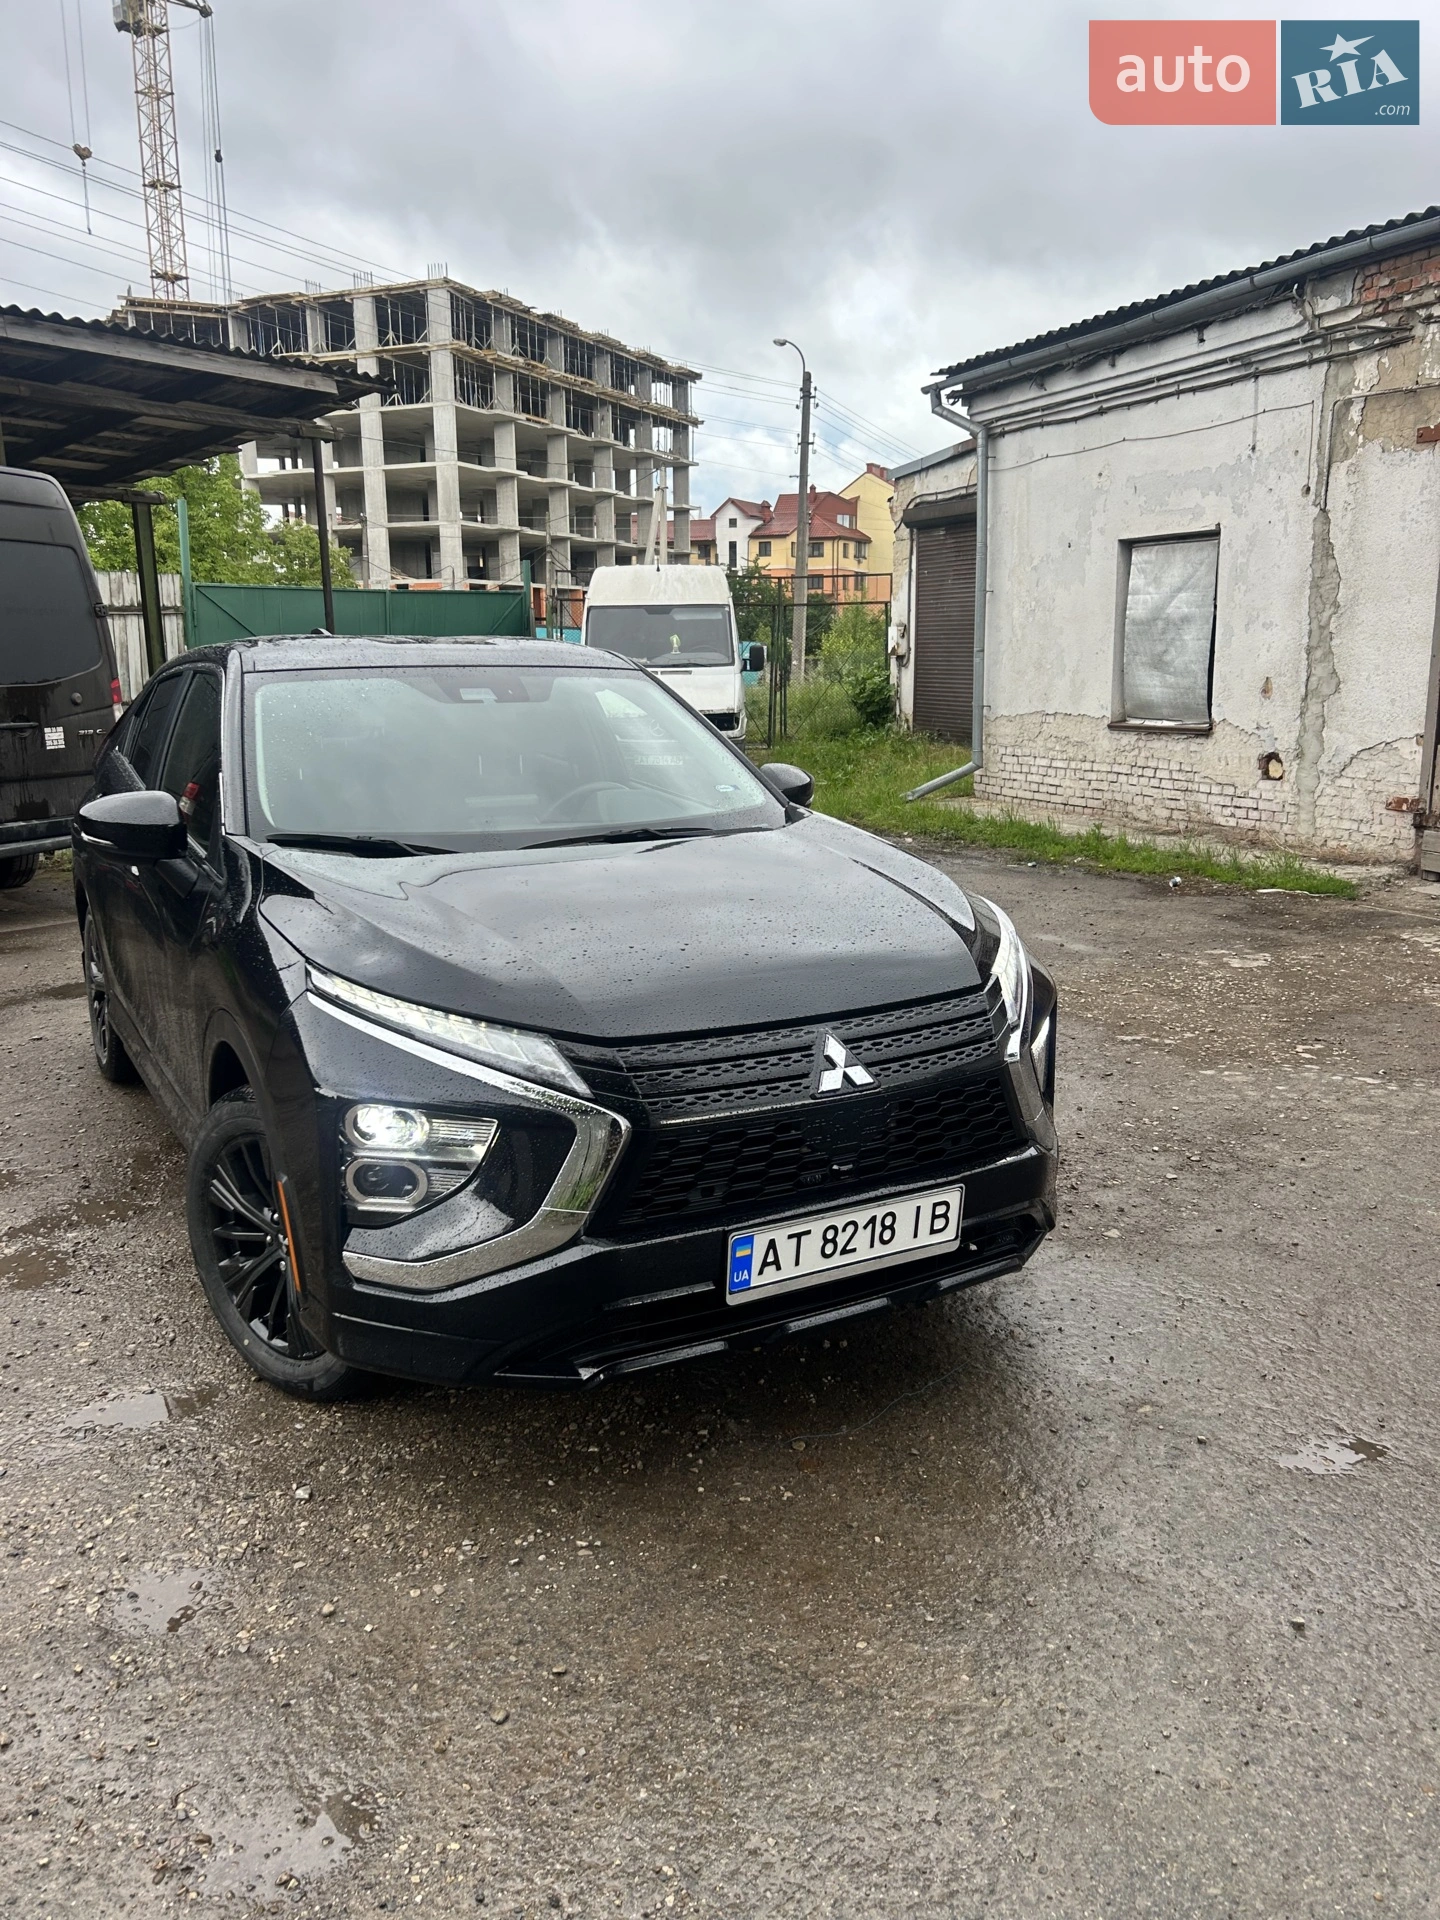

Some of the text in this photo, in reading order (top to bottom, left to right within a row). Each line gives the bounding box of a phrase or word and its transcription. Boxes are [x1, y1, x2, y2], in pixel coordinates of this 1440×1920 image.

[757, 1200, 951, 1276] AT 8218 IB
[733, 1269, 750, 1283] UA
